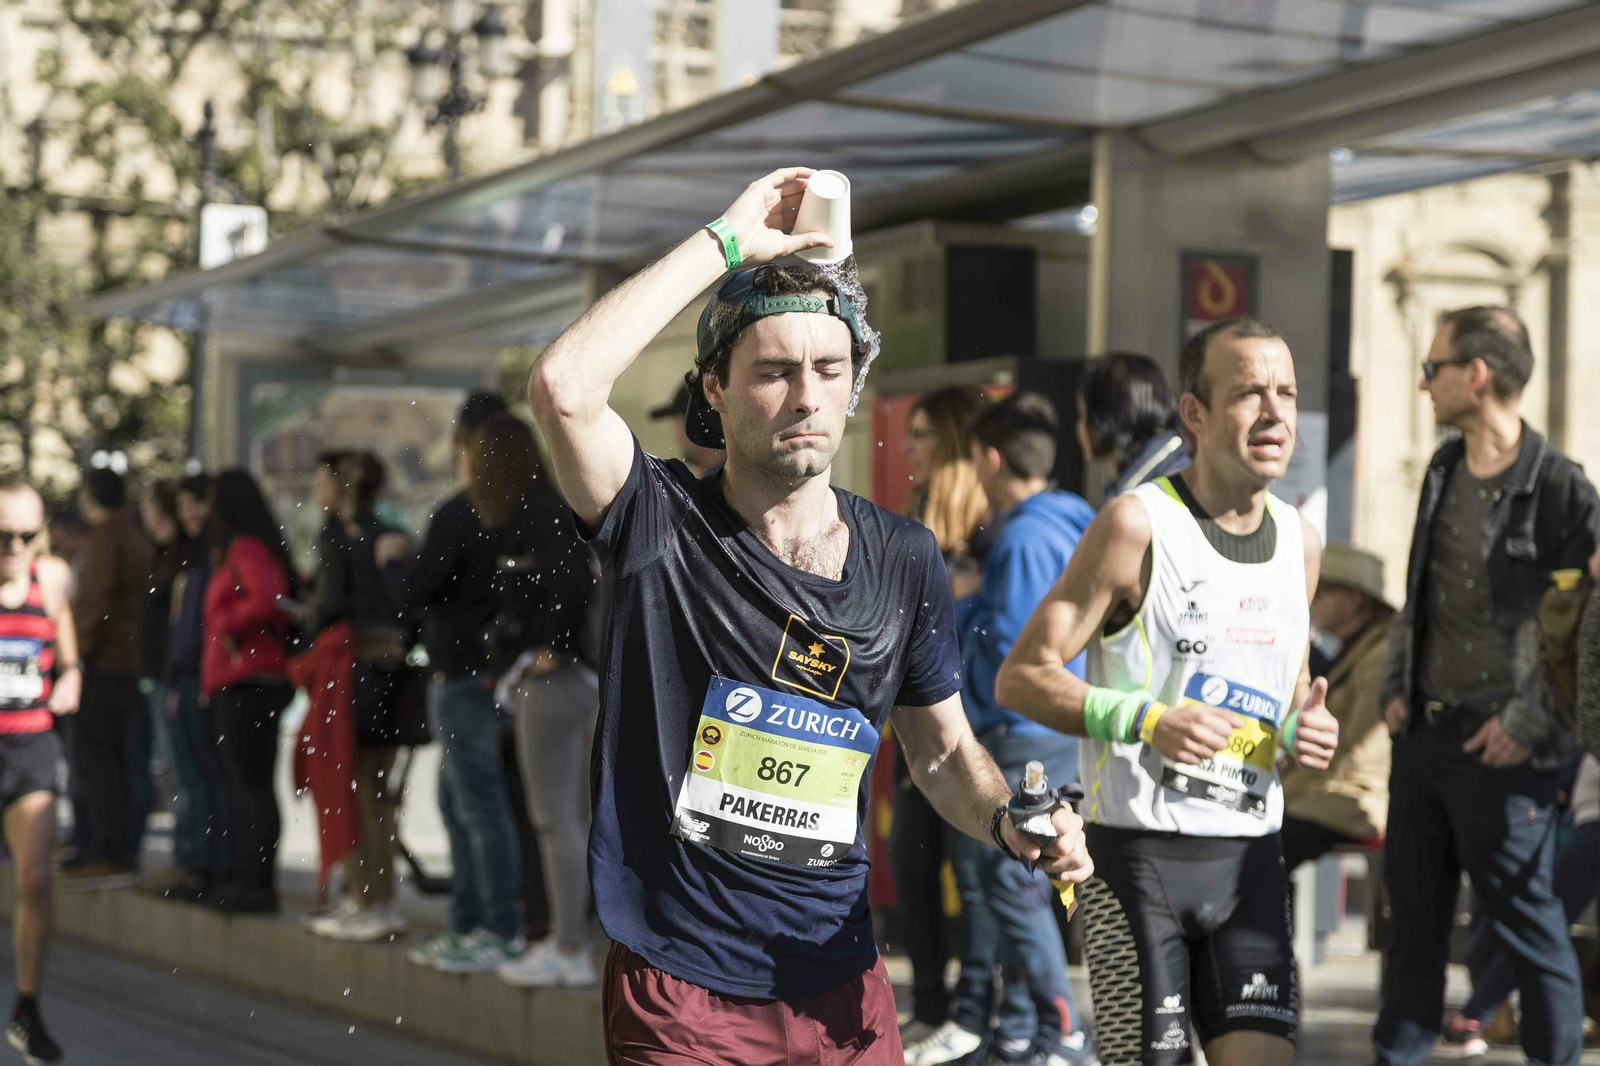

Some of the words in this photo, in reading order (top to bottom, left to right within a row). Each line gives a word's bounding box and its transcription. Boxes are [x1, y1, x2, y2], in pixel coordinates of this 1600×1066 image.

[1176, 639, 1207, 655] GO
[788, 650, 837, 673] SAYSKY
[766, 704, 862, 741] ZURICH
[1226, 736, 1255, 758] 80
[757, 756, 811, 788] 867
[719, 792, 820, 831] PAKERRAS
